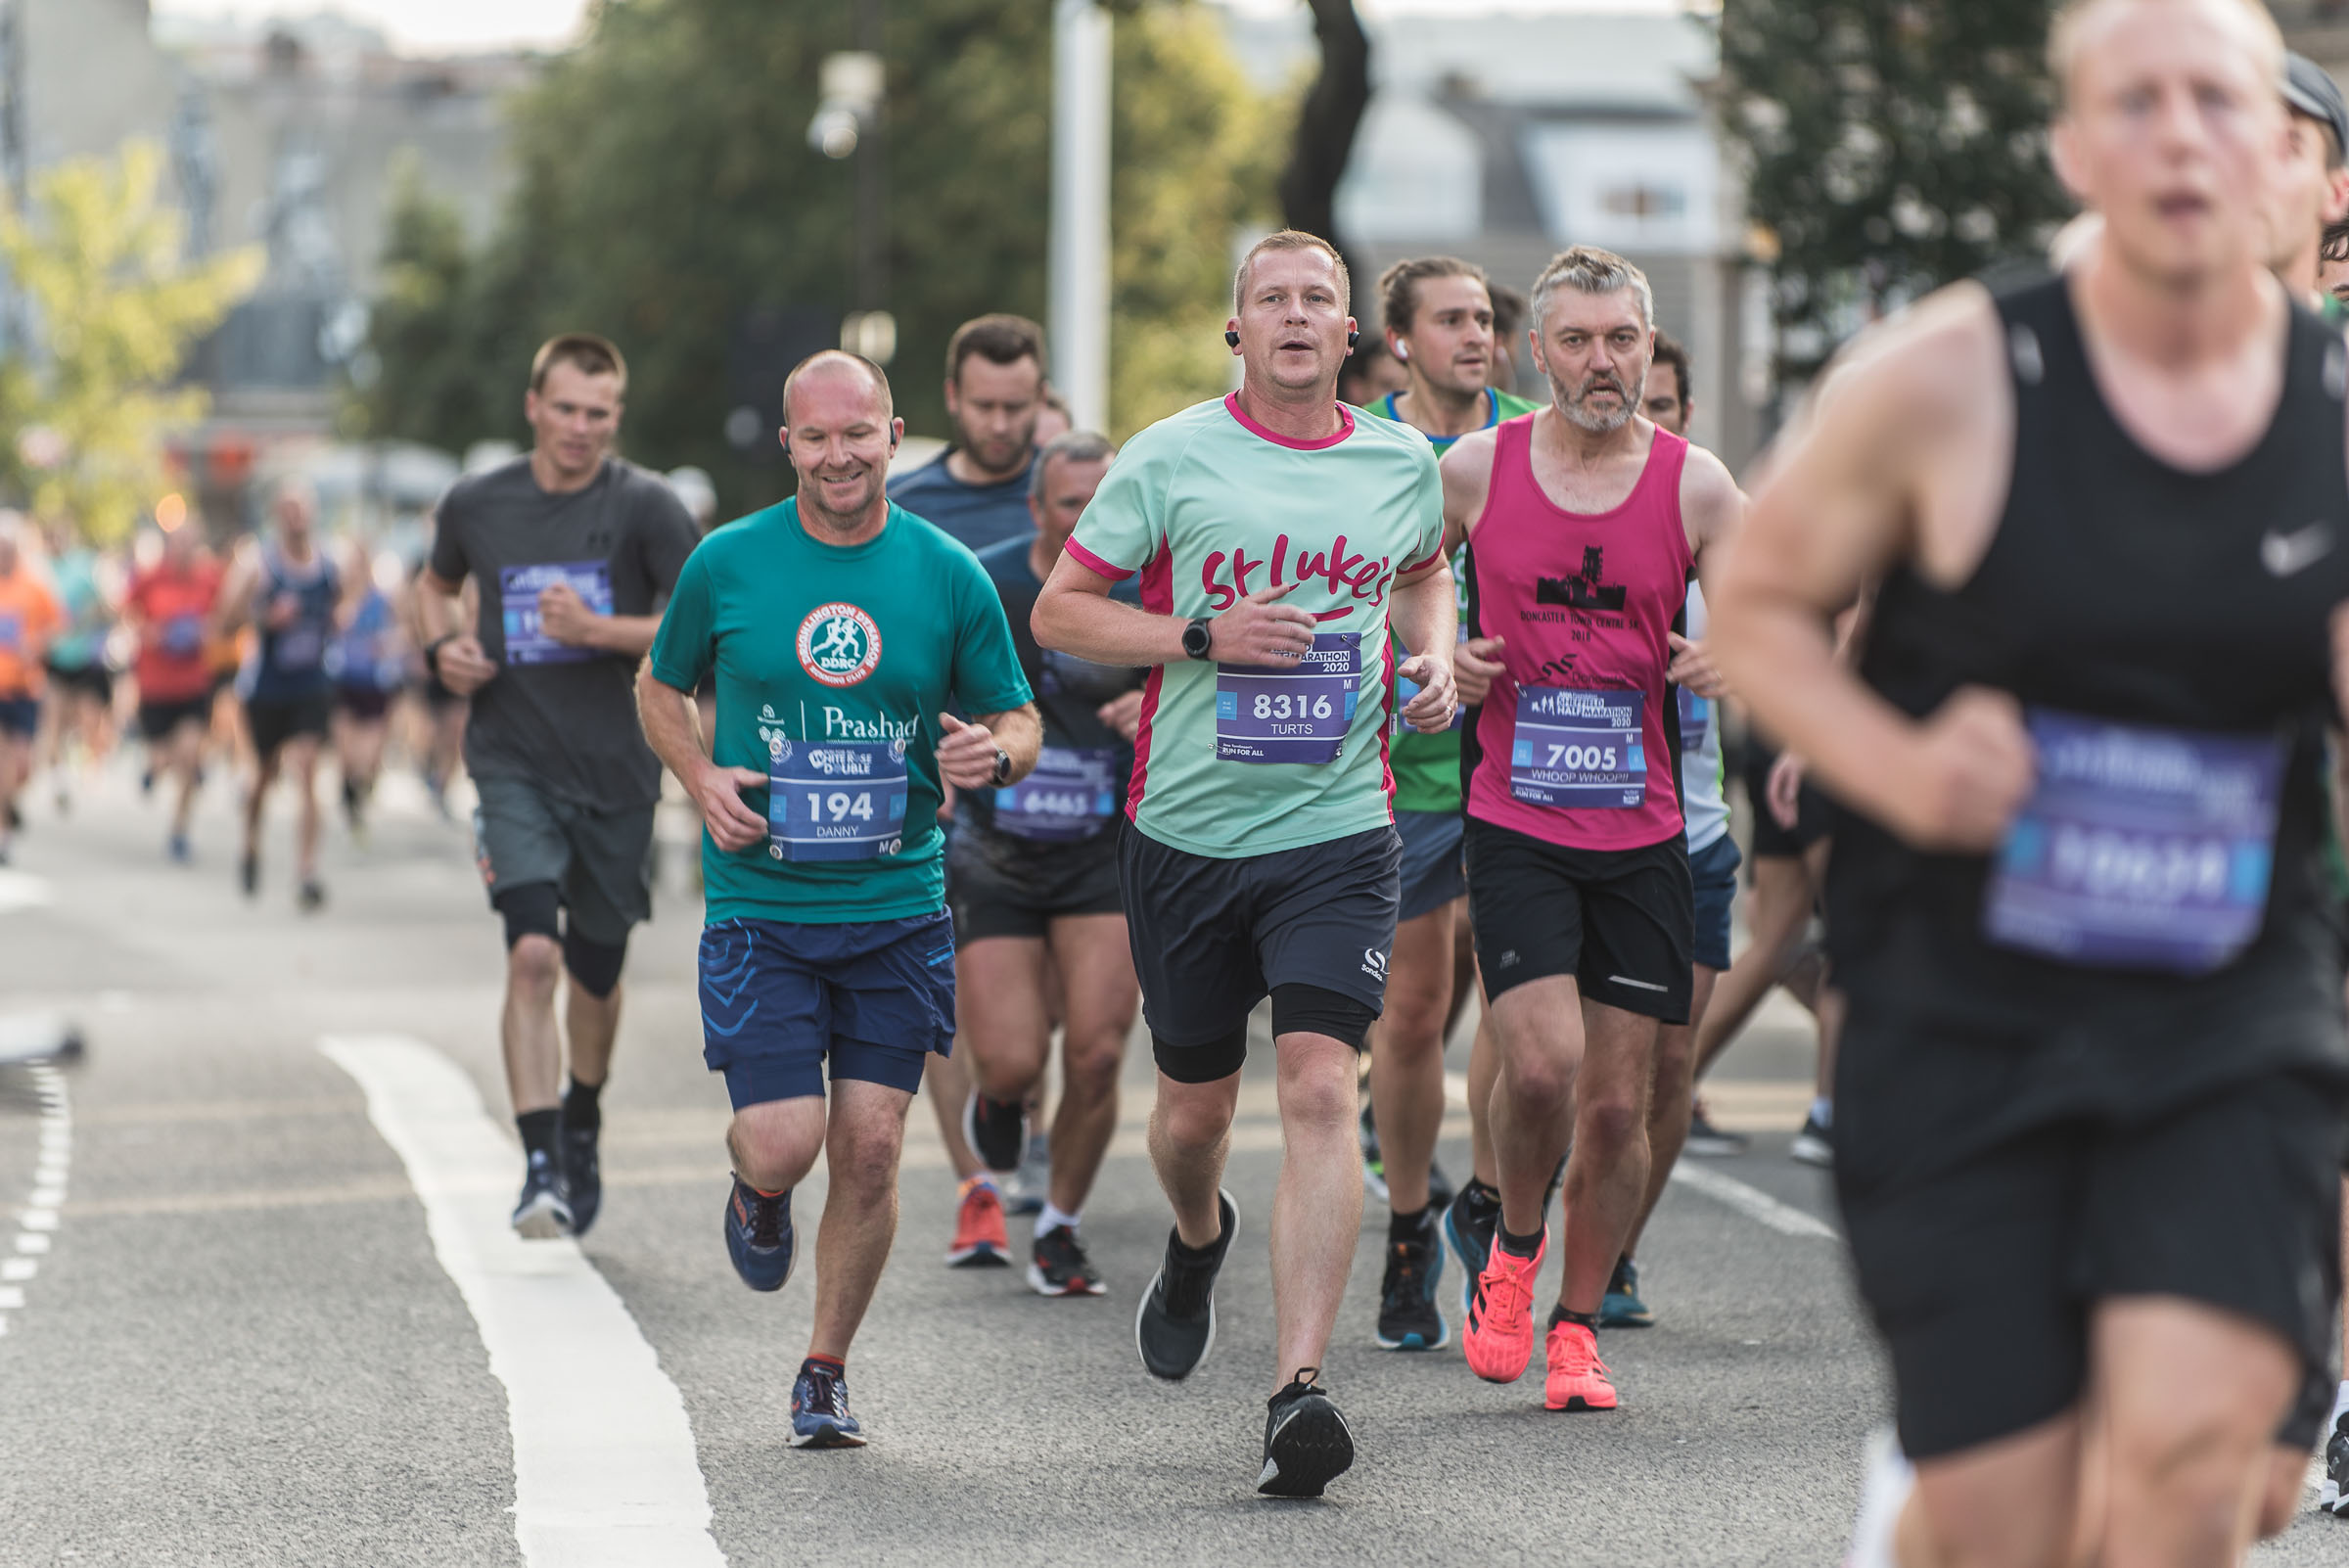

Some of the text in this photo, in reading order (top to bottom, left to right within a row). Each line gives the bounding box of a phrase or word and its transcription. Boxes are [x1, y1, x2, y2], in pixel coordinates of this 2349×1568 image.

[1202, 548, 1264, 611] St
[1520, 611, 1565, 623] DONCASTER
[1570, 613, 1592, 626] TOWN
[1596, 618, 1624, 629] CENTRE
[820, 657, 857, 670] DDRC
[1322, 662, 1350, 672] 2020
[846, 669, 867, 683] CLUB
[1343, 678, 1352, 690] M
[1253, 694, 1332, 719] 8316
[822, 706, 919, 739] Prashad
[1270, 723, 1313, 735] TURTS
[1611, 717, 1632, 728] 2020
[1626, 733, 1634, 744] M
[1545, 744, 1616, 771] 7005
[1532, 768, 1629, 784] WHOOP WHOOP!!
[807, 792, 874, 822] 194
[816, 826, 859, 838] DANNY
[878, 840, 890, 854] M
